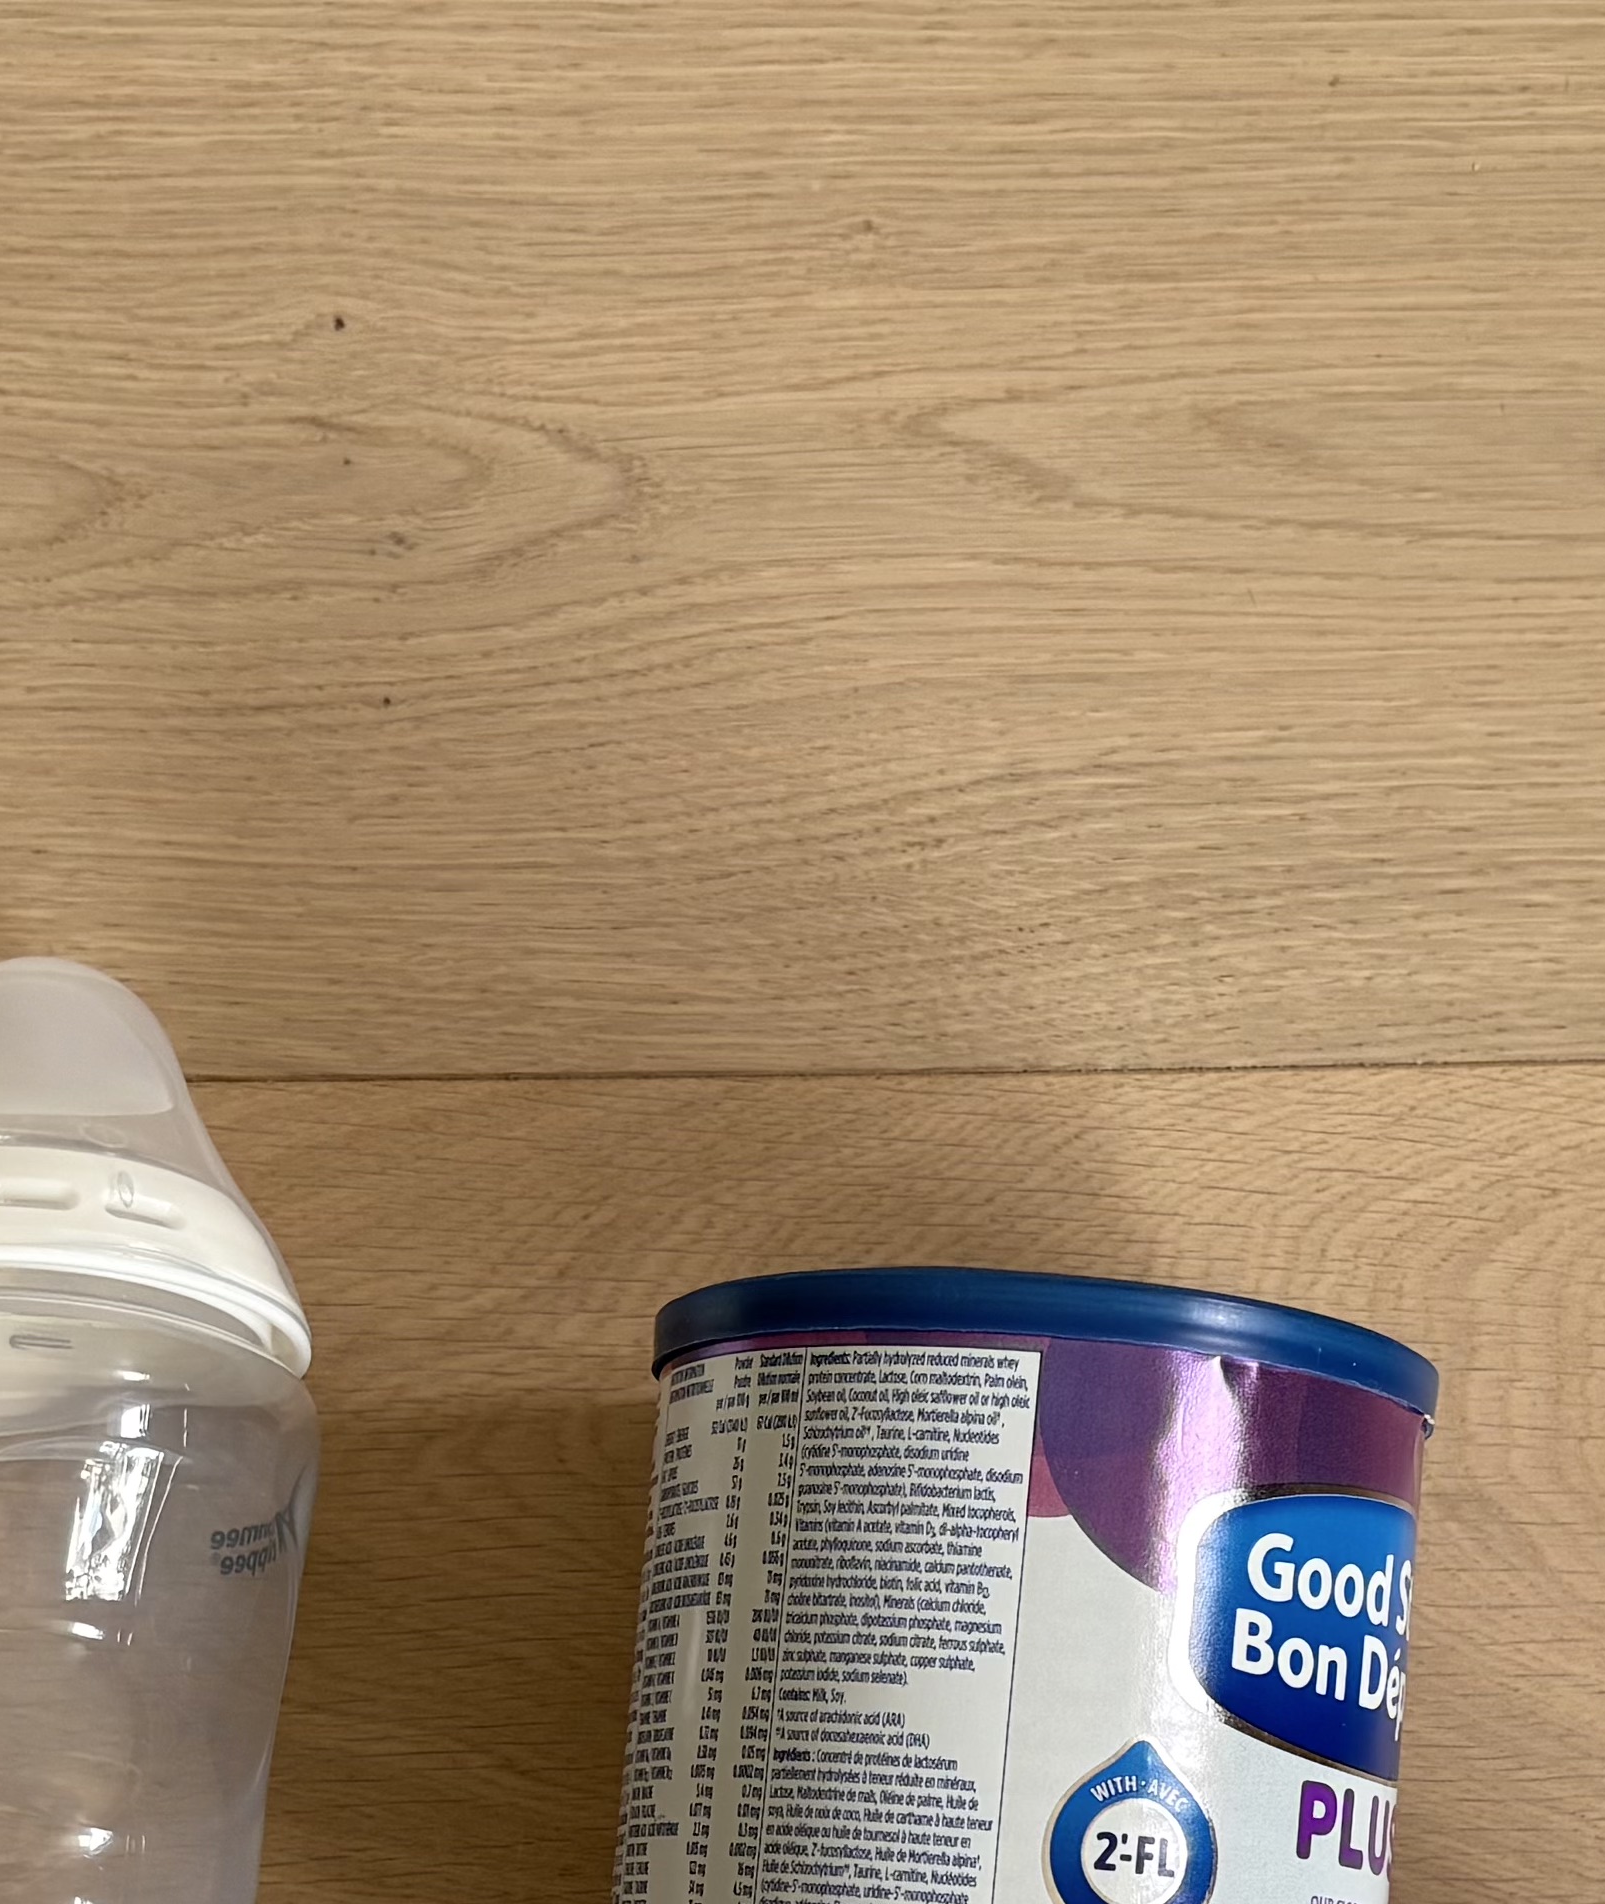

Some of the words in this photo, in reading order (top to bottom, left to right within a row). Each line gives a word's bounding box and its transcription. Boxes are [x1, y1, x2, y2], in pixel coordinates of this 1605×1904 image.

[927, 1352, 959, 1367] reduced
[961, 1353, 995, 1369] minerals
[997, 1355, 1020, 1372] whey
[1247, 1532, 1394, 1627] Good
[1231, 1607, 1348, 1700] Bon
[1090, 1775, 1137, 1802] WITH
[1147, 1778, 1190, 1813] AVEC
[1093, 1831, 1175, 1878] 2'-FL
[1295, 1780, 1396, 1884] PLU
